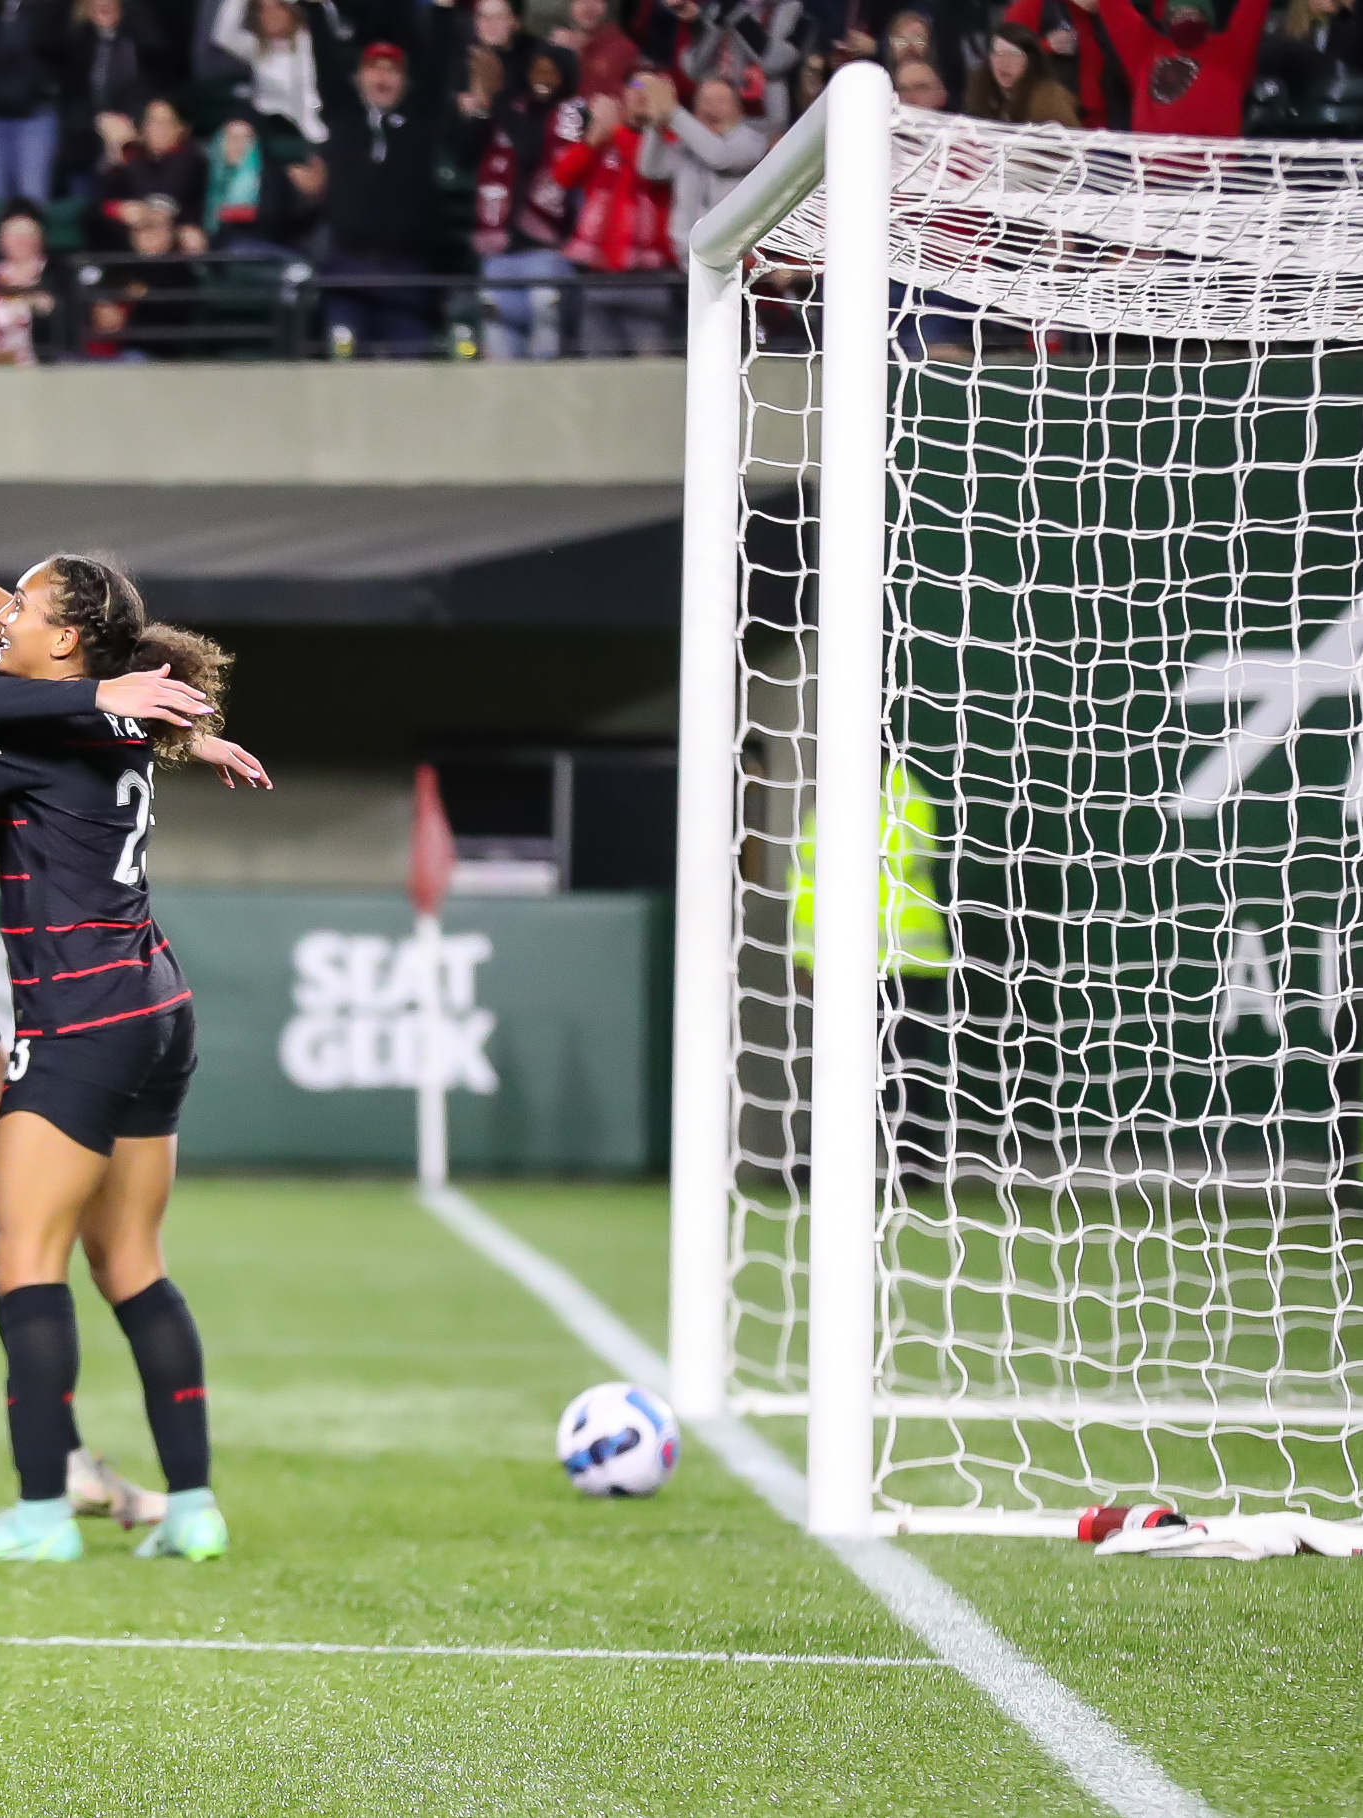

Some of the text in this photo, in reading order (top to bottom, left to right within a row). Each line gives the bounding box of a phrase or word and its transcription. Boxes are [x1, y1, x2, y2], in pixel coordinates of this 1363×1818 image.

[113, 761, 156, 886] 2
[293, 930, 492, 1009] SEAT
[279, 1008, 500, 1095] GEEK
